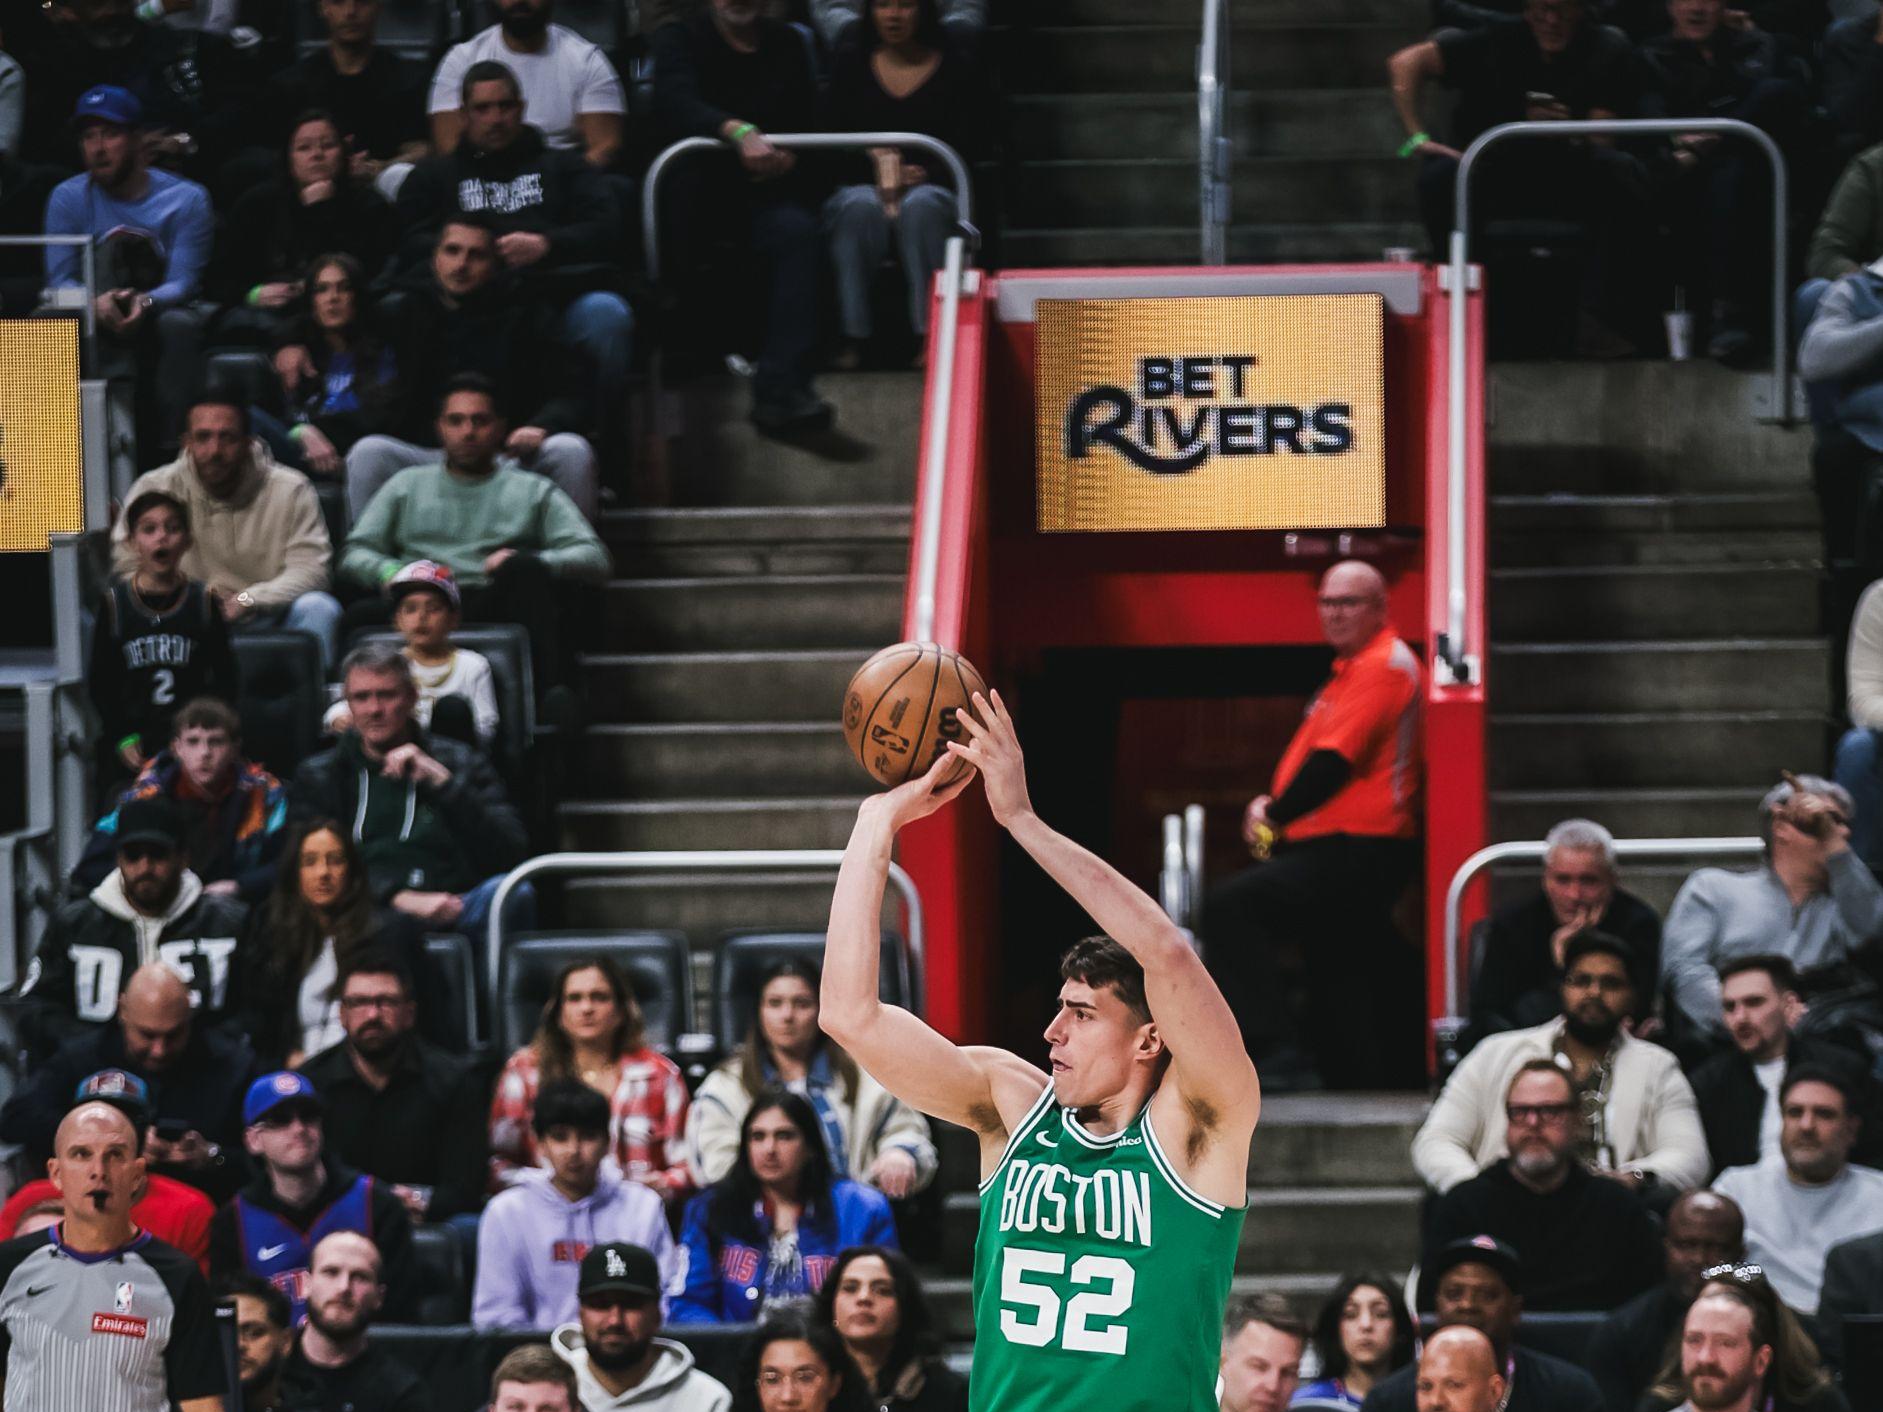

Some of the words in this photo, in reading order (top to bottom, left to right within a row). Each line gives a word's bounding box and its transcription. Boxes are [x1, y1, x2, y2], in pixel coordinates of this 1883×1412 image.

[1143, 356, 1257, 399] BET
[151, 668, 176, 705] 2
[998, 1159, 1152, 1247] BOSTON
[1000, 1246, 1136, 1356] 52
[93, 1315, 147, 1337] Emirates
